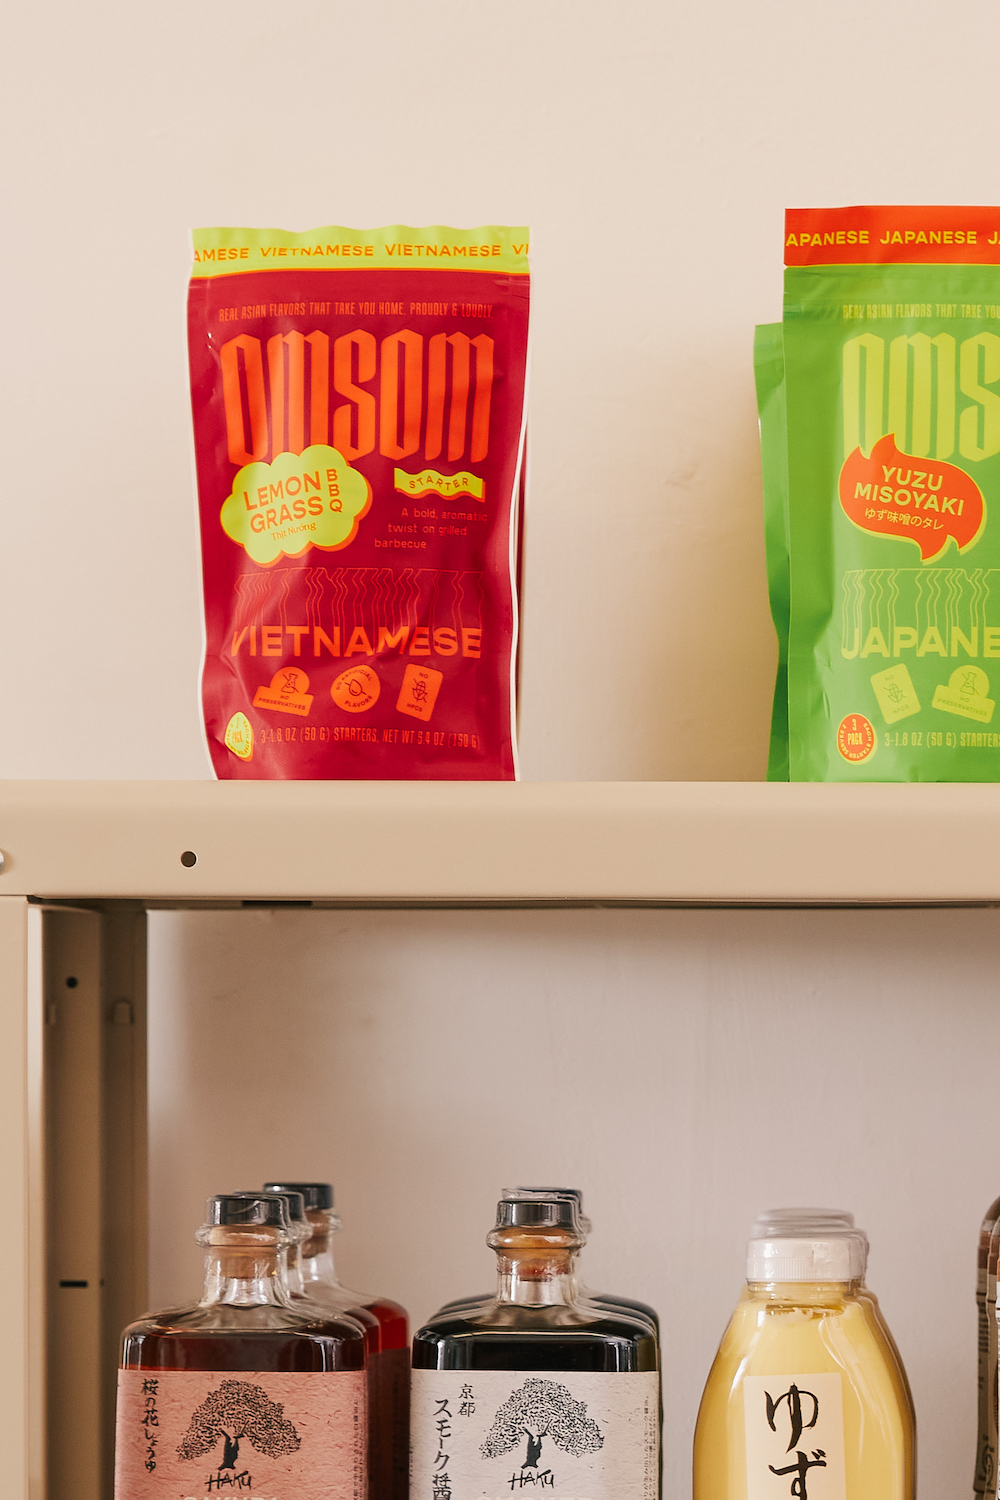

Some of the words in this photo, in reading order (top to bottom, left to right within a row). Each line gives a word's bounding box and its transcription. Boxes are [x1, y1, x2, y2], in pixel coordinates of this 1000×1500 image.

[260, 245, 374, 258] VIETNAMESE
[385, 243, 501, 258] VIETNAMESE
[880, 230, 977, 245] JAPANESE
[242, 471, 321, 510] LEMON
[327, 468, 343, 513] BBQ
[409, 476, 470, 491] STARTER
[882, 465, 944, 491] YUZU
[250, 496, 324, 533] GRASS
[854, 483, 964, 516] MISOYAKI
[231, 626, 482, 658] VIETNAMESE
[457, 1383, 475, 1417] 京都
[141, 1378, 159, 1473] 桜の花しょうゆ
